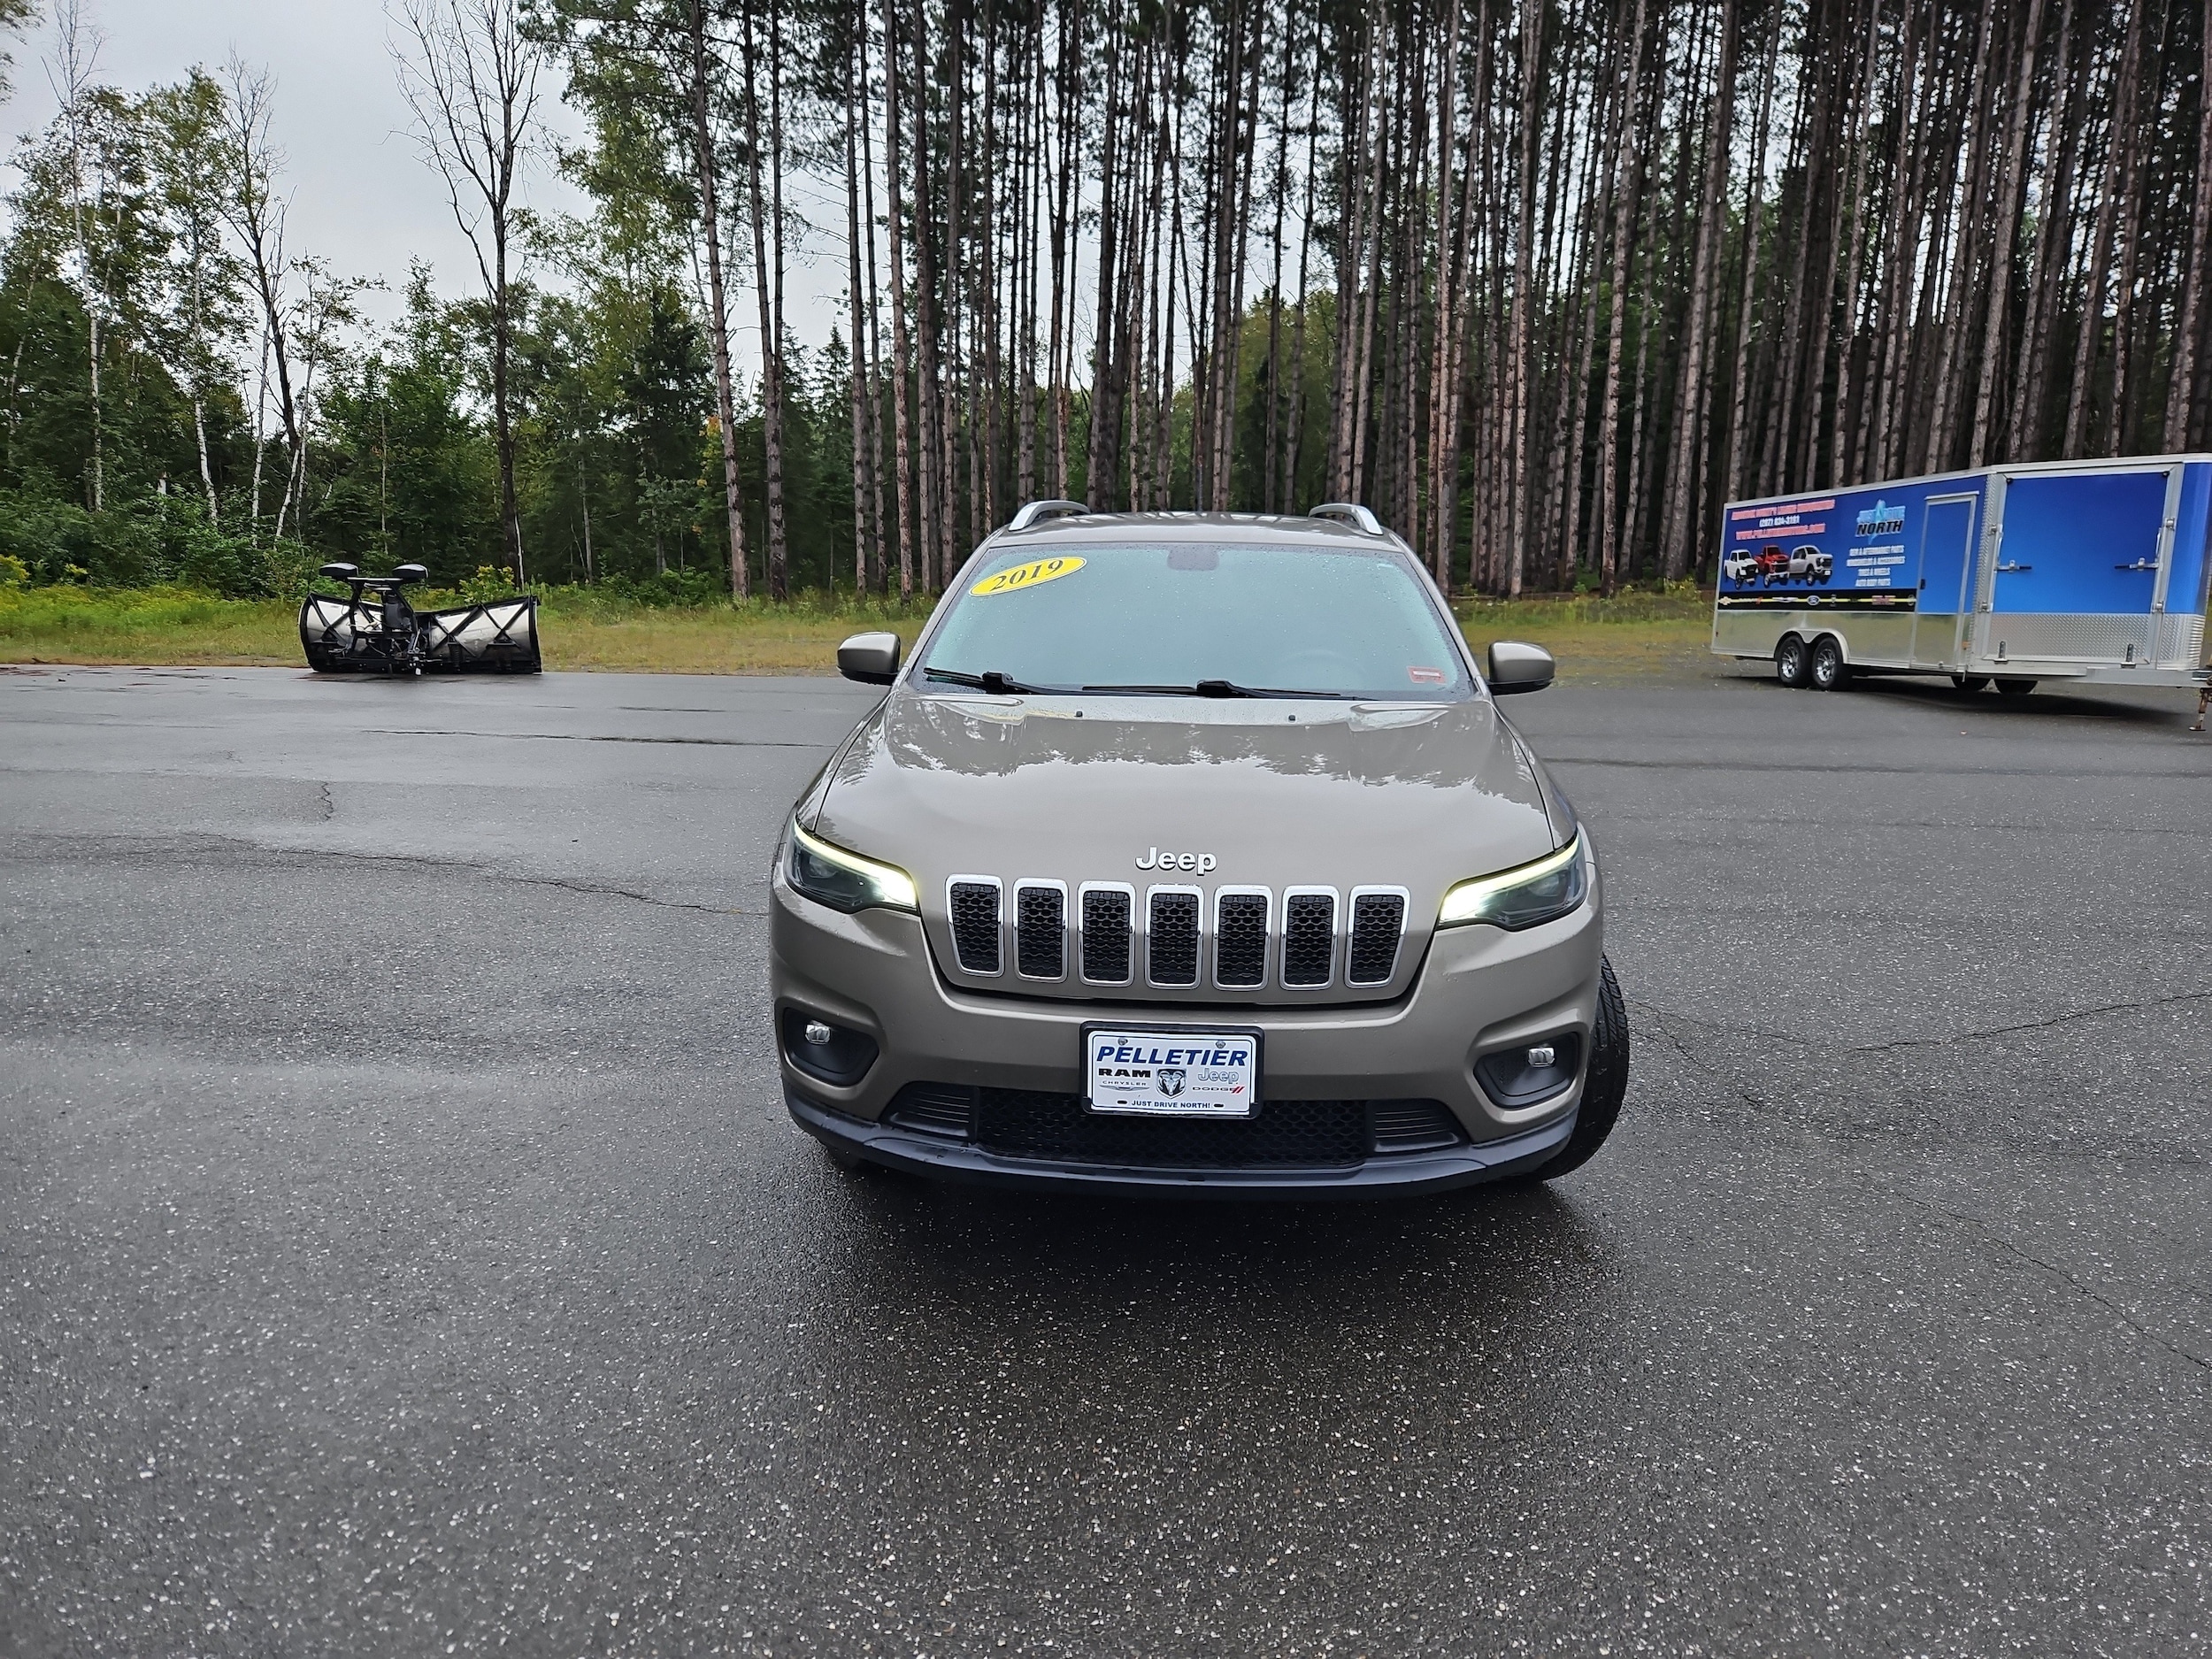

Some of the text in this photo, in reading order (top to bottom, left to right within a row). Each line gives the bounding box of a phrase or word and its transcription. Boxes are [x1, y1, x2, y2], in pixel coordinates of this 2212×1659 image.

[1855, 520, 1904, 536] NORTH
[989, 559, 1064, 592] 2019
[1135, 846, 1217, 877] Jeep
[1096, 1045, 1248, 1067] PELLETIER
[1098, 1067, 1151, 1079] RAM
[1197, 1067, 1240, 1085] Jeep
